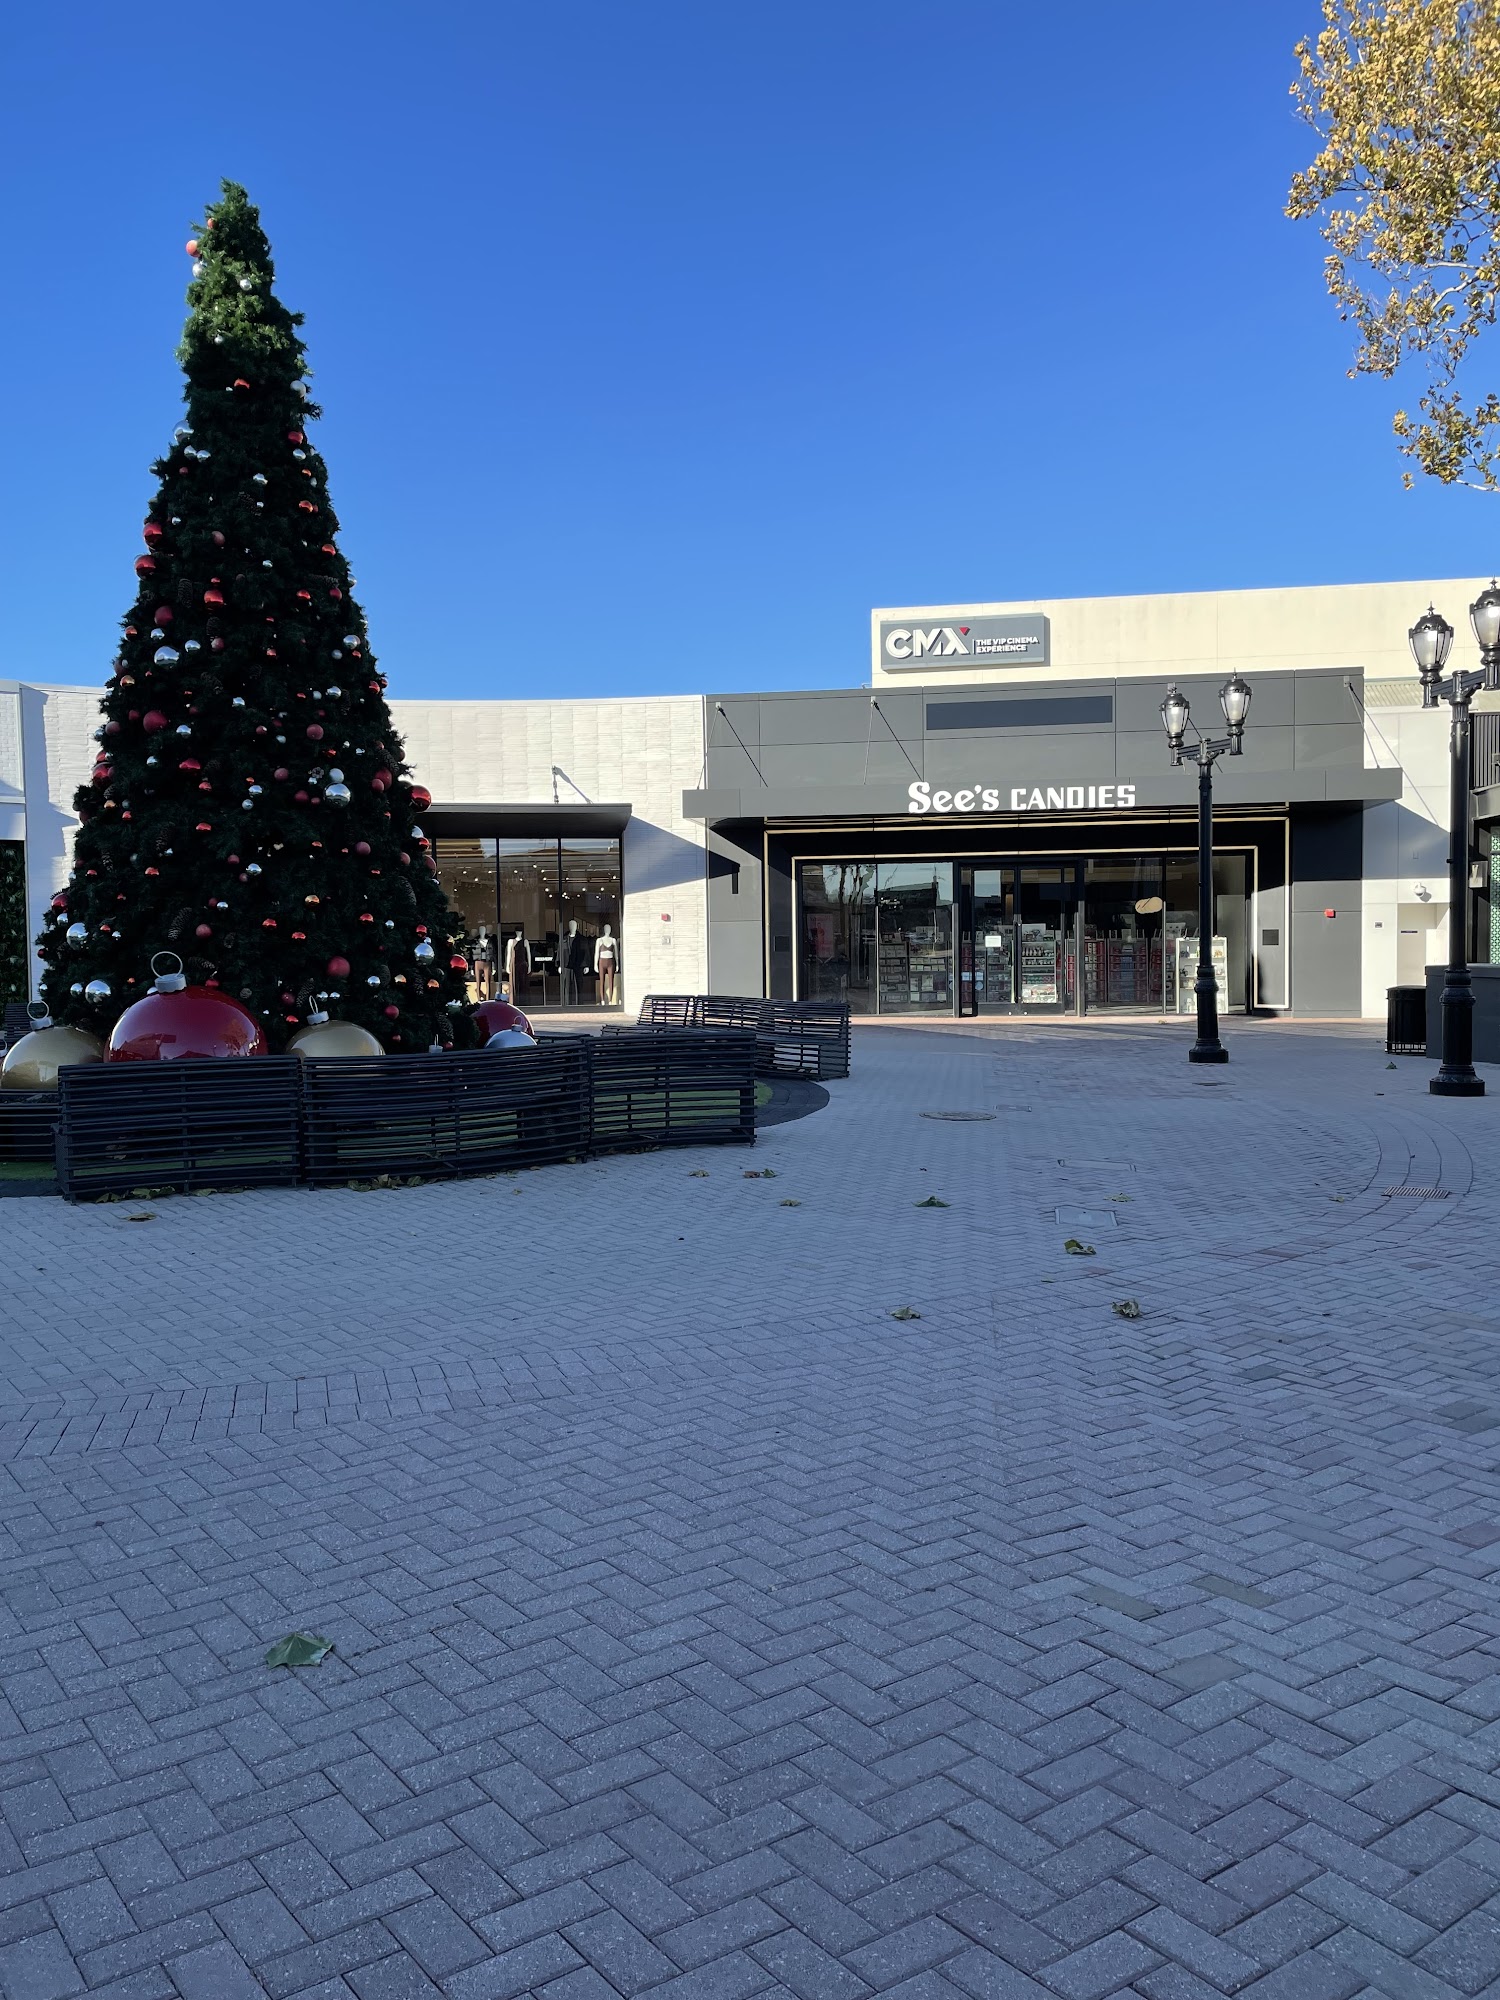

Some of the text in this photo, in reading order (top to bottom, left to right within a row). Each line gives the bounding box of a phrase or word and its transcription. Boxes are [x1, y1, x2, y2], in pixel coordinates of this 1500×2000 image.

[885, 627, 970, 659] CMX
[975, 636, 1039, 646] THE VIP CINEMA
[976, 644, 1027, 653] EXPERIENCE
[908, 781, 1136, 813] See's CANDIES
